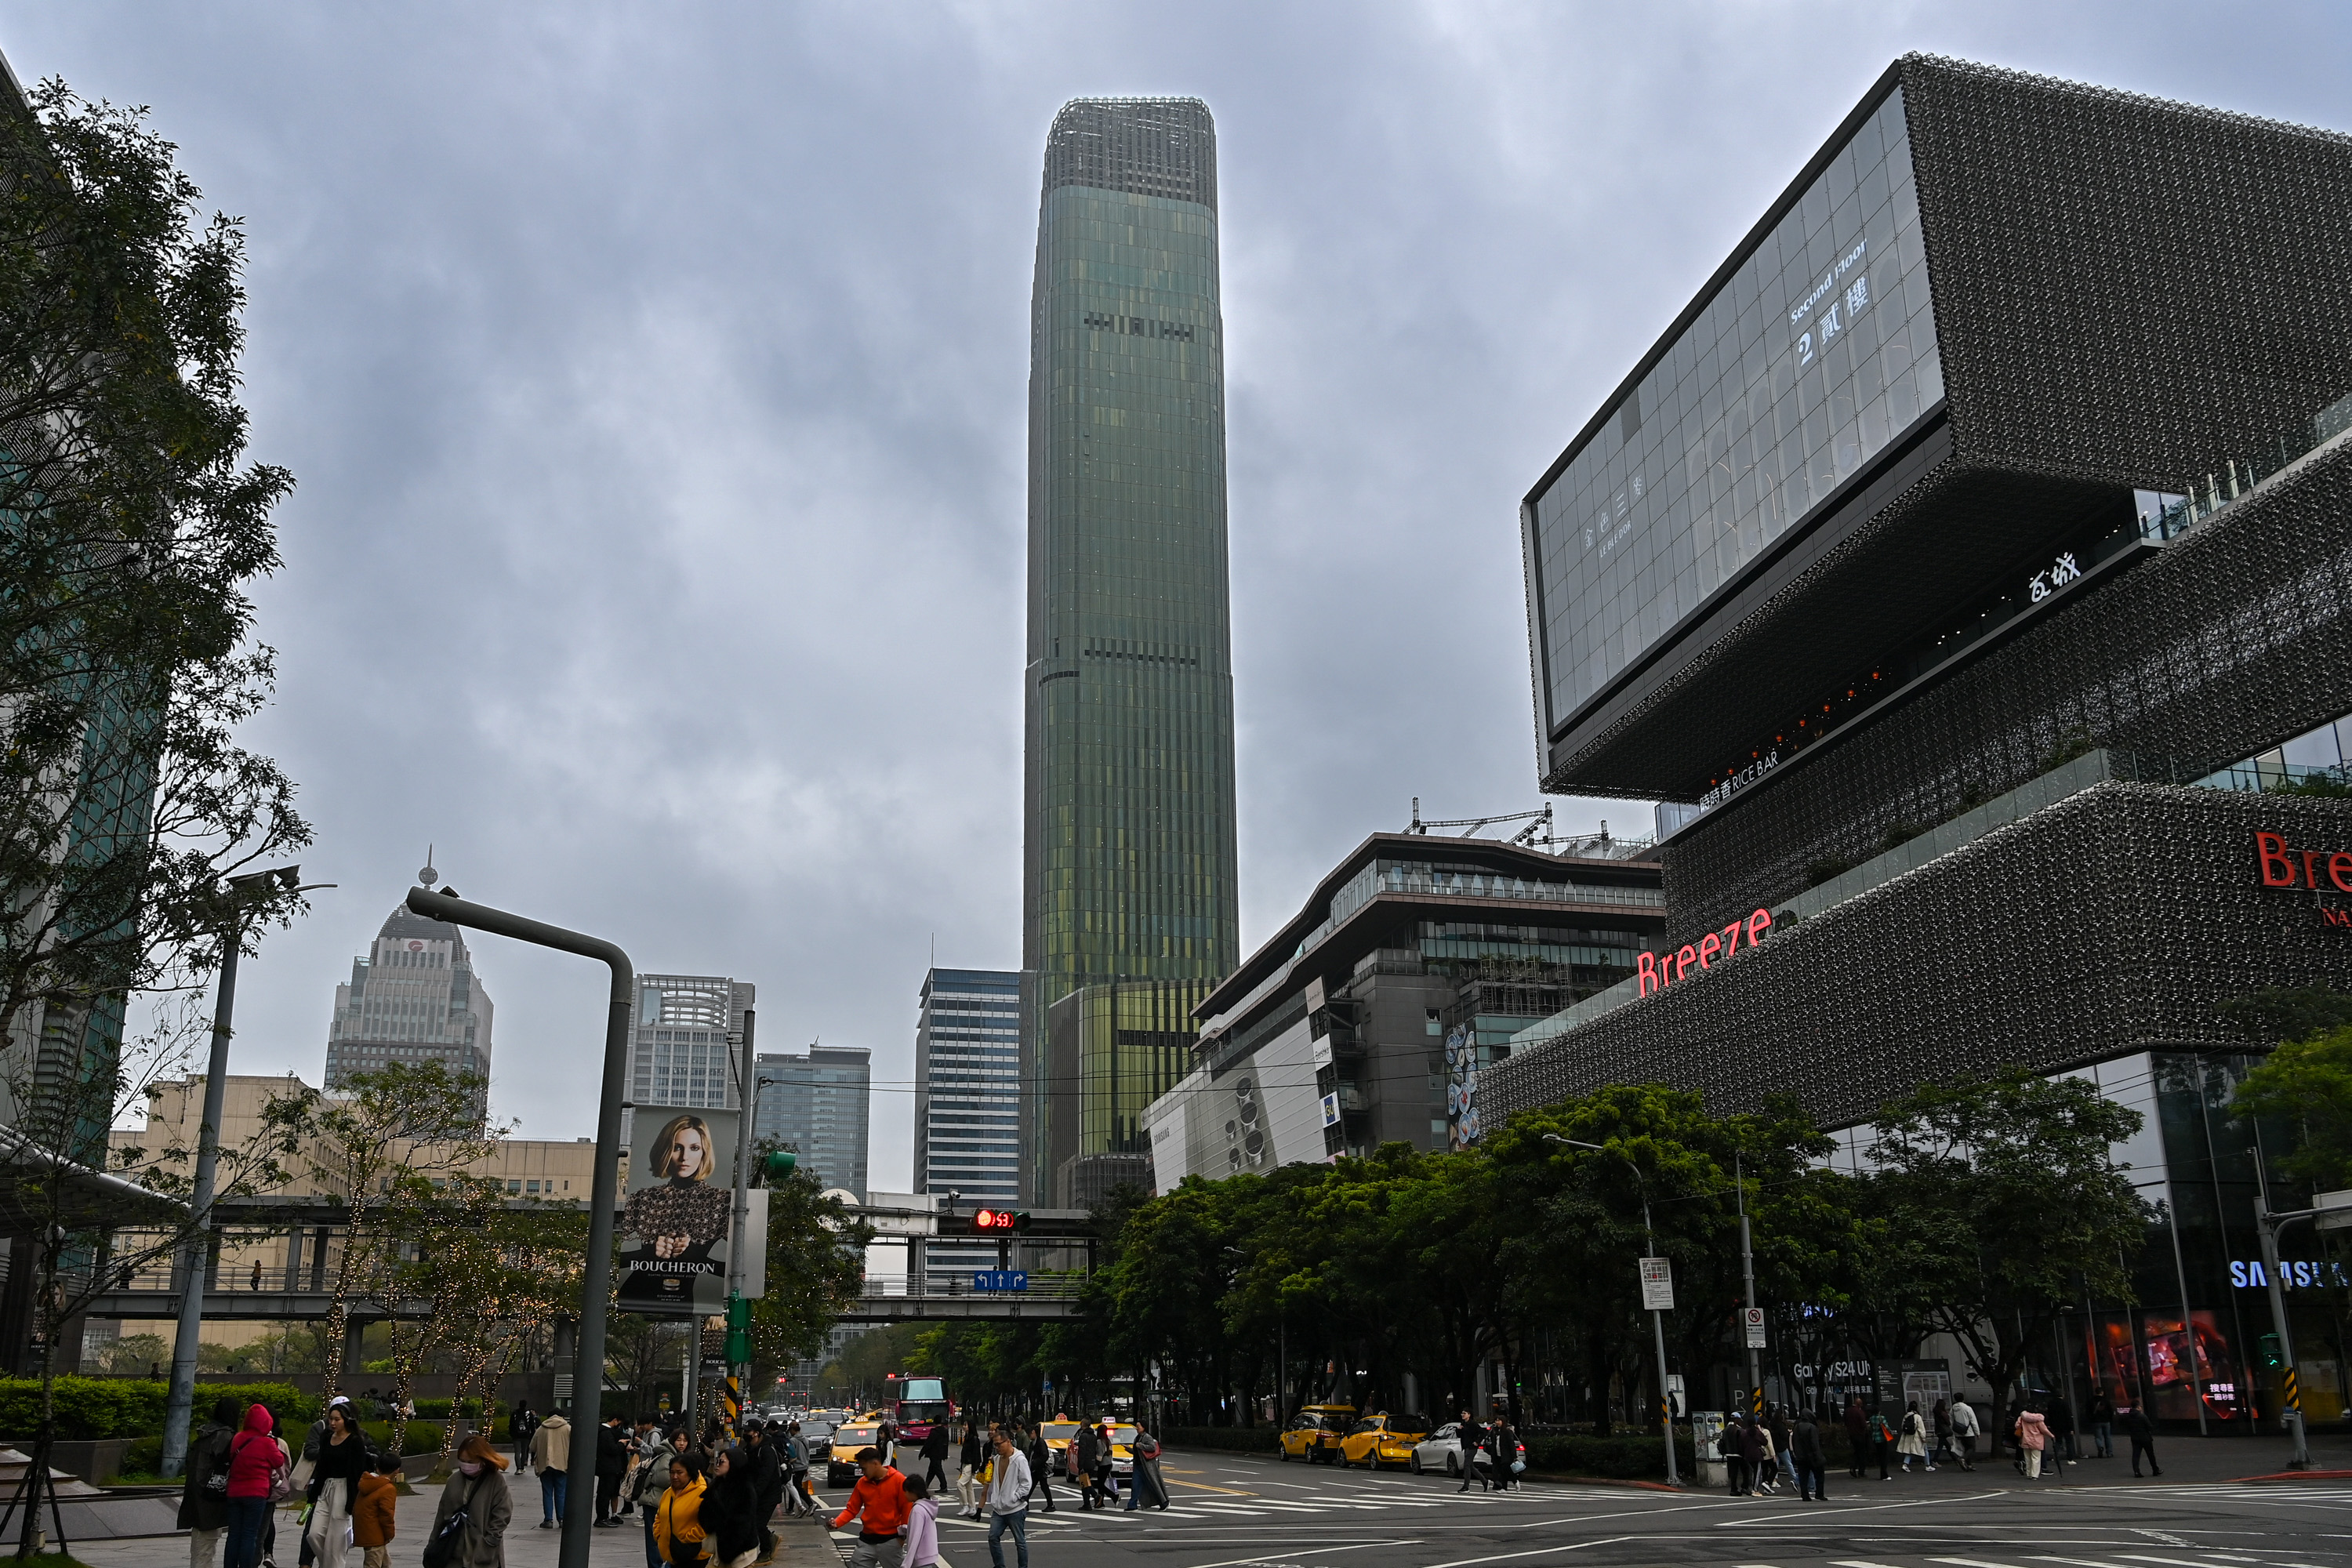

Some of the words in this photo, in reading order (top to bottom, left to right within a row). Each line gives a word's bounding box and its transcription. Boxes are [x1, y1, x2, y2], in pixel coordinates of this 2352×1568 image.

[1834, 238, 1868, 280] Floor
[1733, 764, 1755, 792] RICE
[1756, 751, 1778, 776] BAR
[1637, 908, 1773, 999] Breeze
[1325, 1103, 1334, 1117] GU
[1153, 1127, 1170, 1145] SAMSUNG
[996, 1213, 1009, 1227] 53
[630, 1259, 715, 1274] BOUCHERON
[1835, 1360, 1855, 1377] S24
[1734, 1389, 1745, 1406] P
